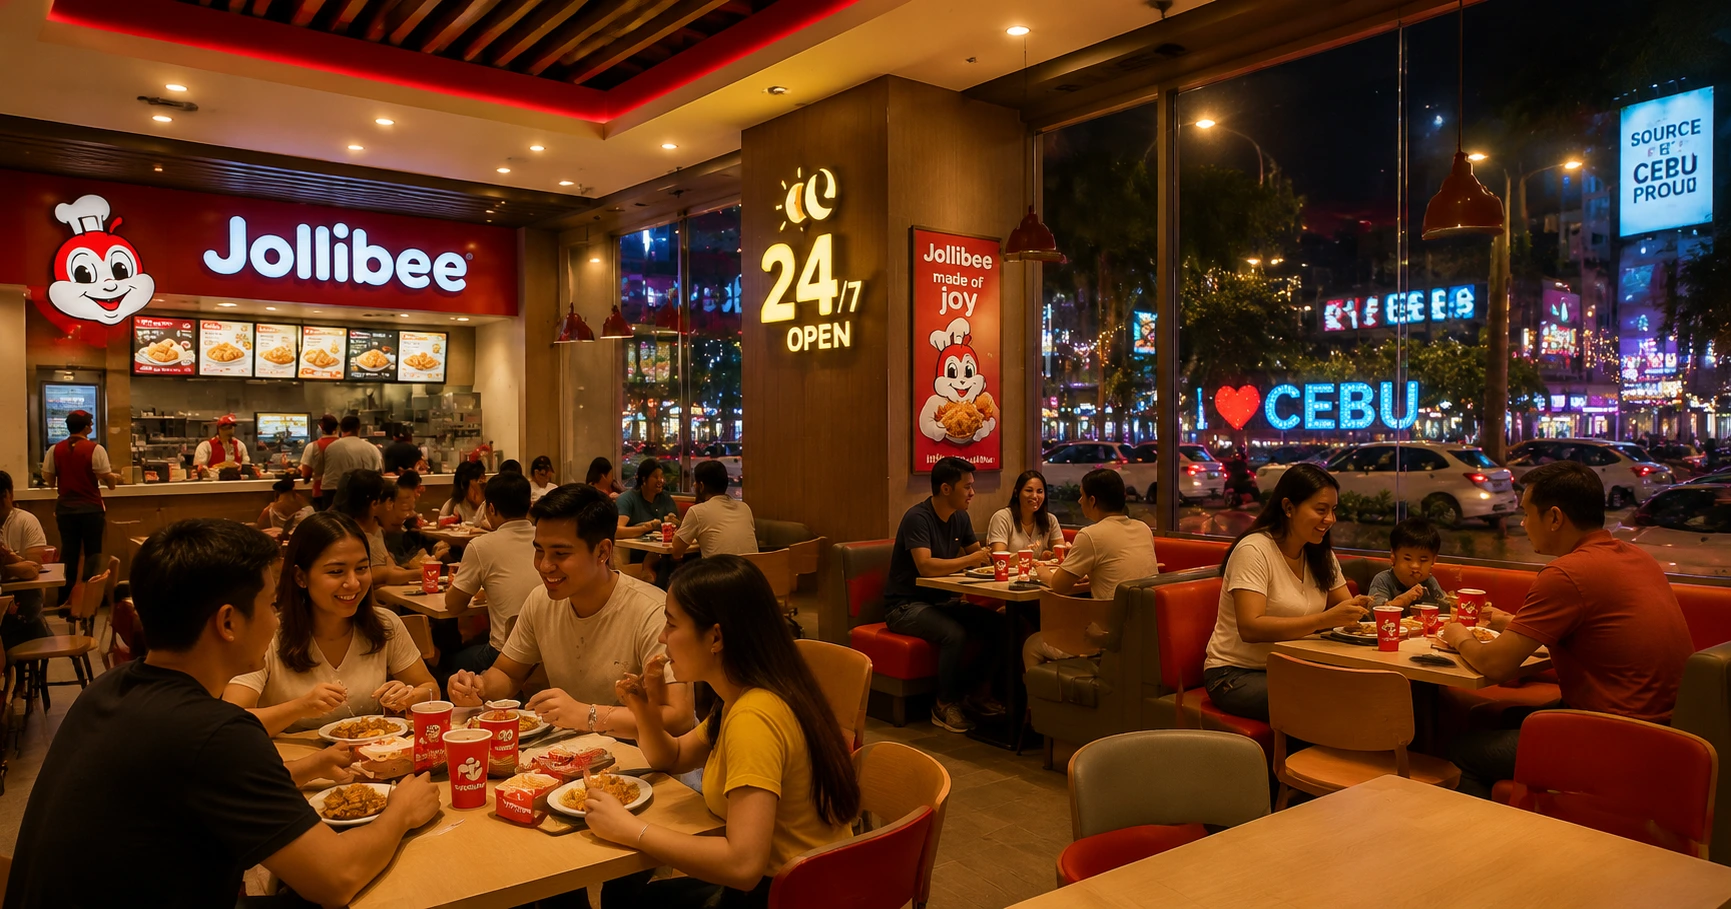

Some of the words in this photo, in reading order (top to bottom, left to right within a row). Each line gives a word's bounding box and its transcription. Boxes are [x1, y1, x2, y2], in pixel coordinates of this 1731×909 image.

[1631, 118, 1701, 147] SOURCE
[1633, 153, 1698, 184] CEBU
[203, 215, 468, 292] Jollibee
[923, 243, 993, 270] Jollibee
[761, 233, 862, 324] 24/7
[933, 272, 968, 287] made
[971, 276, 984, 289] of
[939, 286, 978, 317] joy
[786, 320, 851, 352] OPEN
[1264, 380, 1419, 430] CEBU
